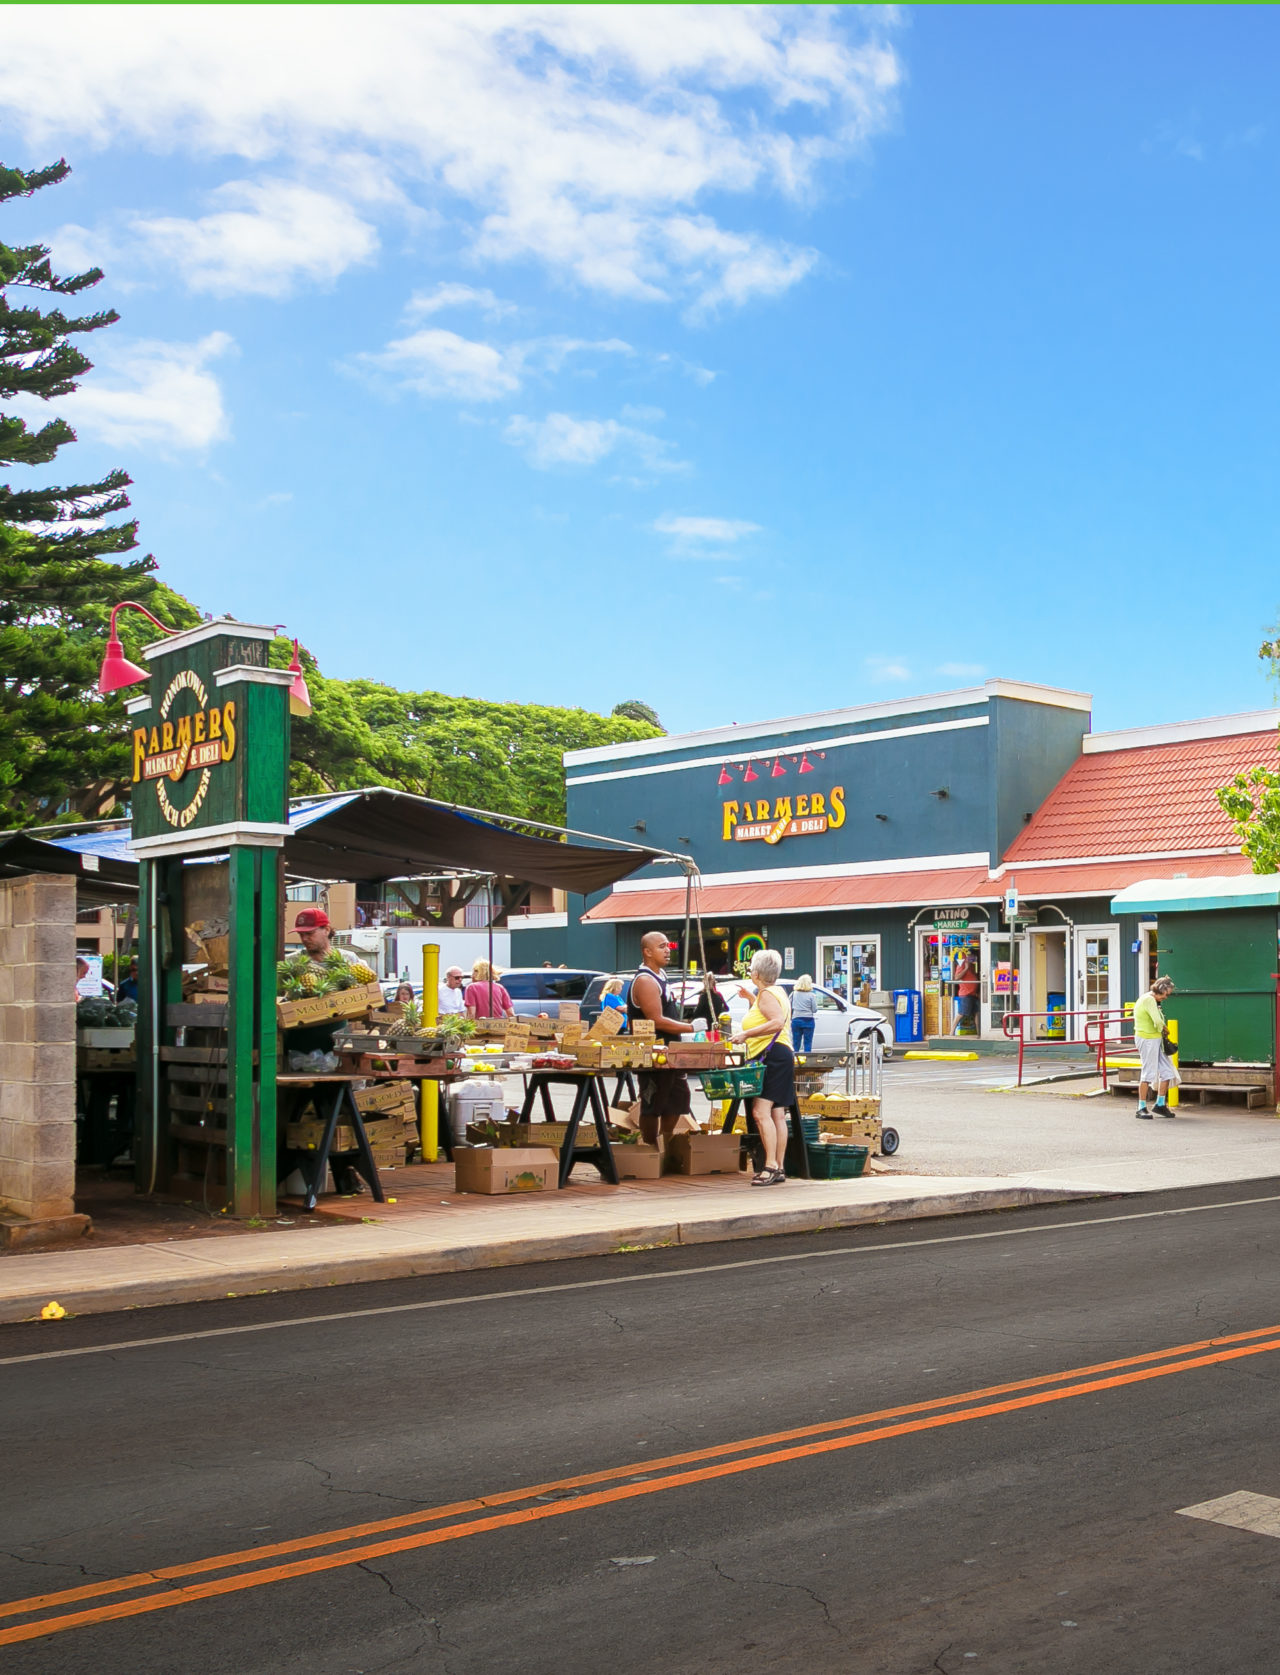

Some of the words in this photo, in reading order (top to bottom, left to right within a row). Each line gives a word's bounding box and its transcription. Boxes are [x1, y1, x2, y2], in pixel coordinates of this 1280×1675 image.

[160, 669, 209, 720] HONOKOWAI
[132, 701, 236, 783] FARMERS
[144, 753, 178, 777] MARKET
[190, 750, 198, 766] &
[199, 743, 219, 765] DELI
[155, 777, 179, 827] BEACH
[180, 767, 212, 828] CENTER
[722, 785, 846, 840] FARMERS
[736, 825, 771, 838] MARKET
[790, 822, 797, 833] &
[801, 819, 823, 832] DELI
[934, 908, 969, 920] LATINO
[937, 921, 964, 929] MARKET
[295, 1002, 331, 1017] MAUI
[335, 992, 369, 1008] GOLD
